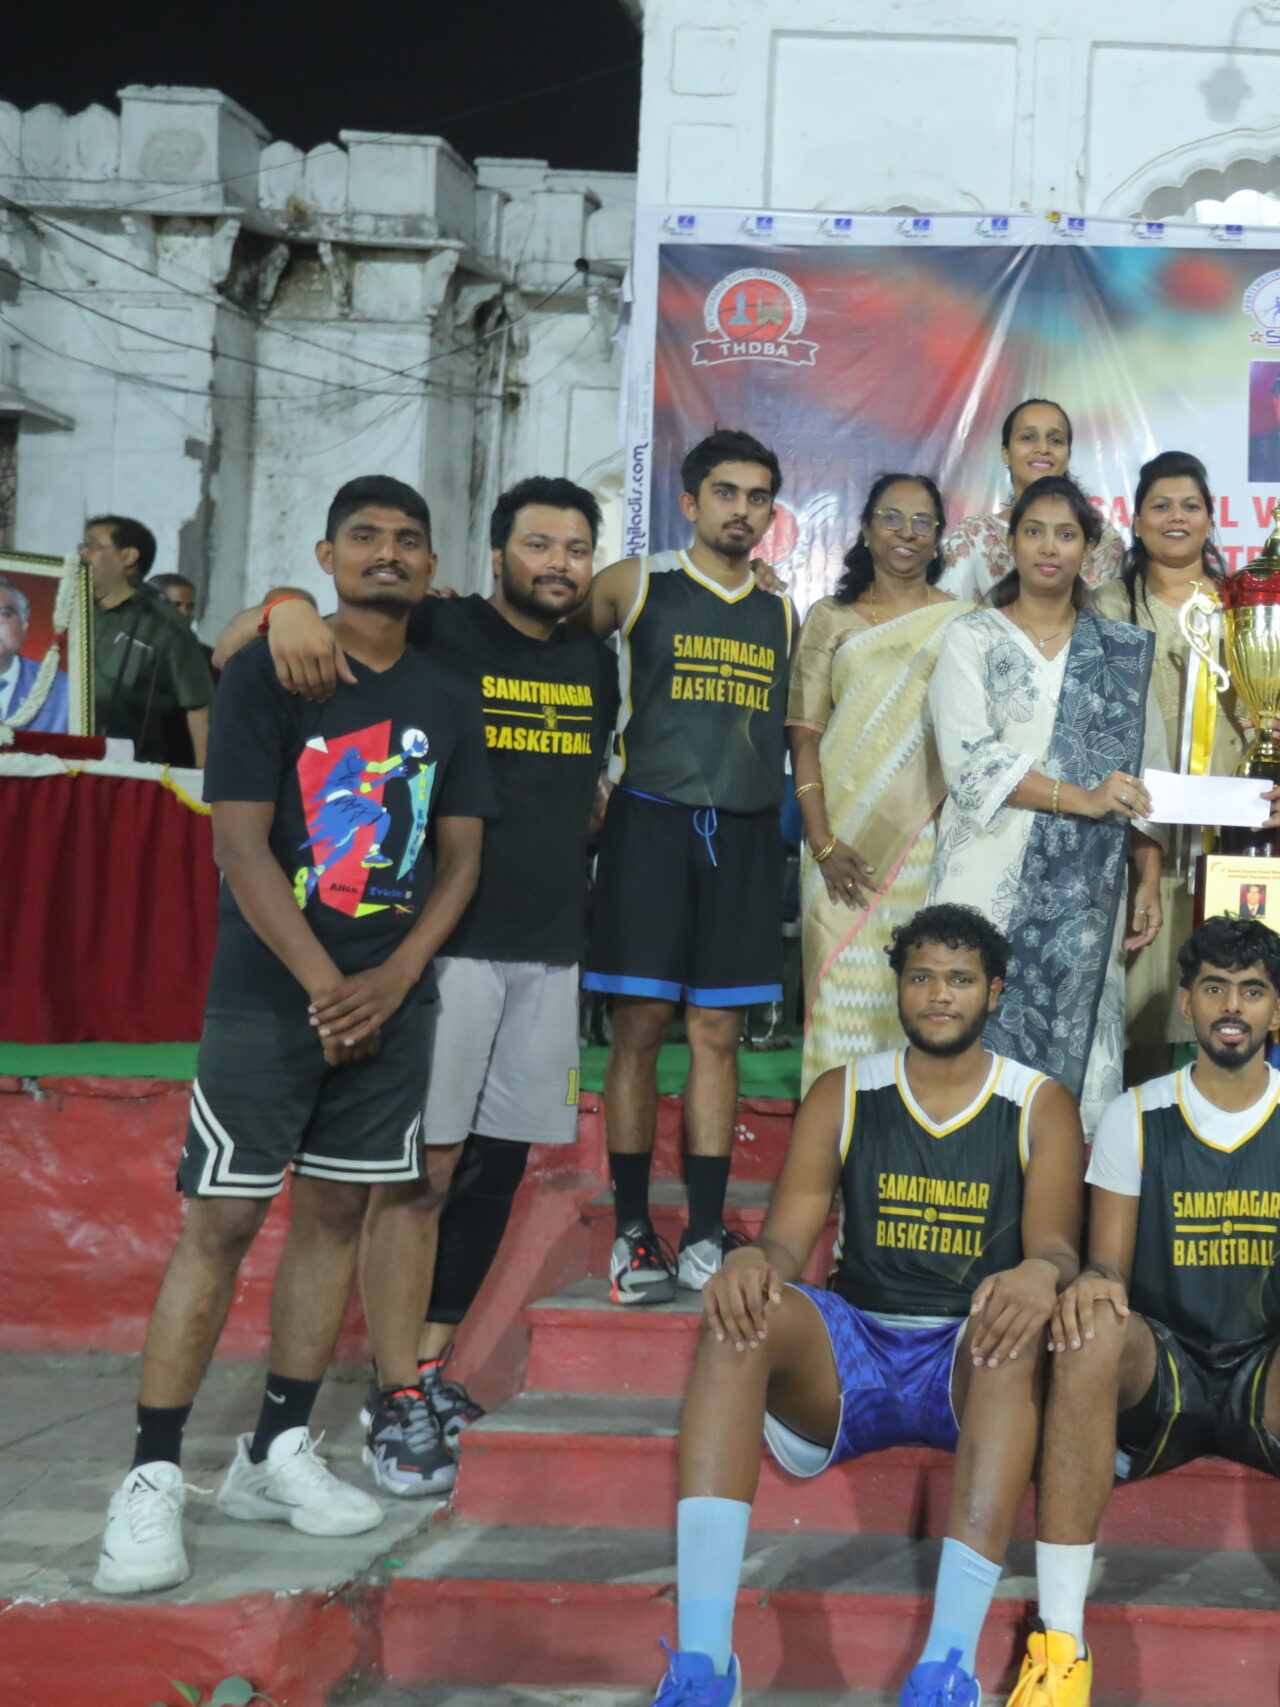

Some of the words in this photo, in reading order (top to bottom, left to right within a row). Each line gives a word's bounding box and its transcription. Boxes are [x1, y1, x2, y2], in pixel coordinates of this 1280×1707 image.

[719, 341, 789, 357] THDBA
[674, 634, 775, 671] SANATHNAGAR
[482, 675, 593, 706] SANATHNAGAR
[671, 676, 770, 712] BASKETBALL
[484, 725, 592, 754] BASKETBALL
[878, 1173, 990, 1209] SANATHNAGAR
[876, 1220, 983, 1257] BASKETBALL
[1173, 1238, 1275, 1266] BASKETBALL
